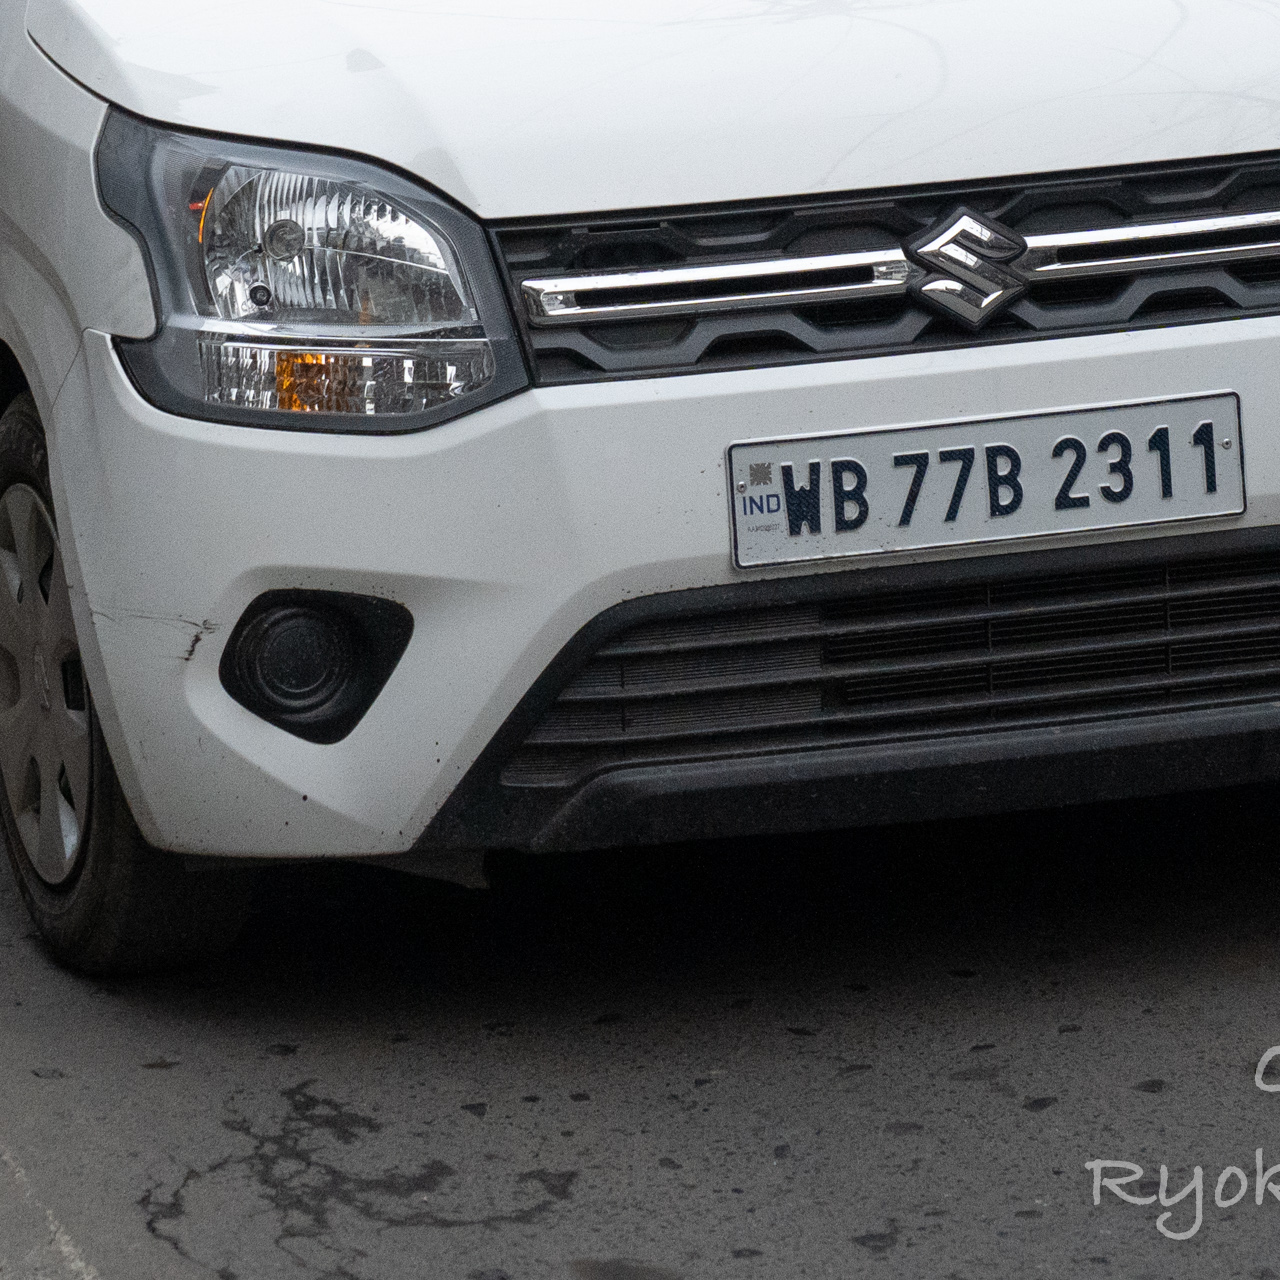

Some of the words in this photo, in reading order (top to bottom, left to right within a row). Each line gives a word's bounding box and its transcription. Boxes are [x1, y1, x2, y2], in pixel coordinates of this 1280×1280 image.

[742, 493, 782, 516] IND
[780, 460, 870, 536] WB
[893, 444, 1024, 527] 77B
[1051, 421, 1216, 510] 2311
